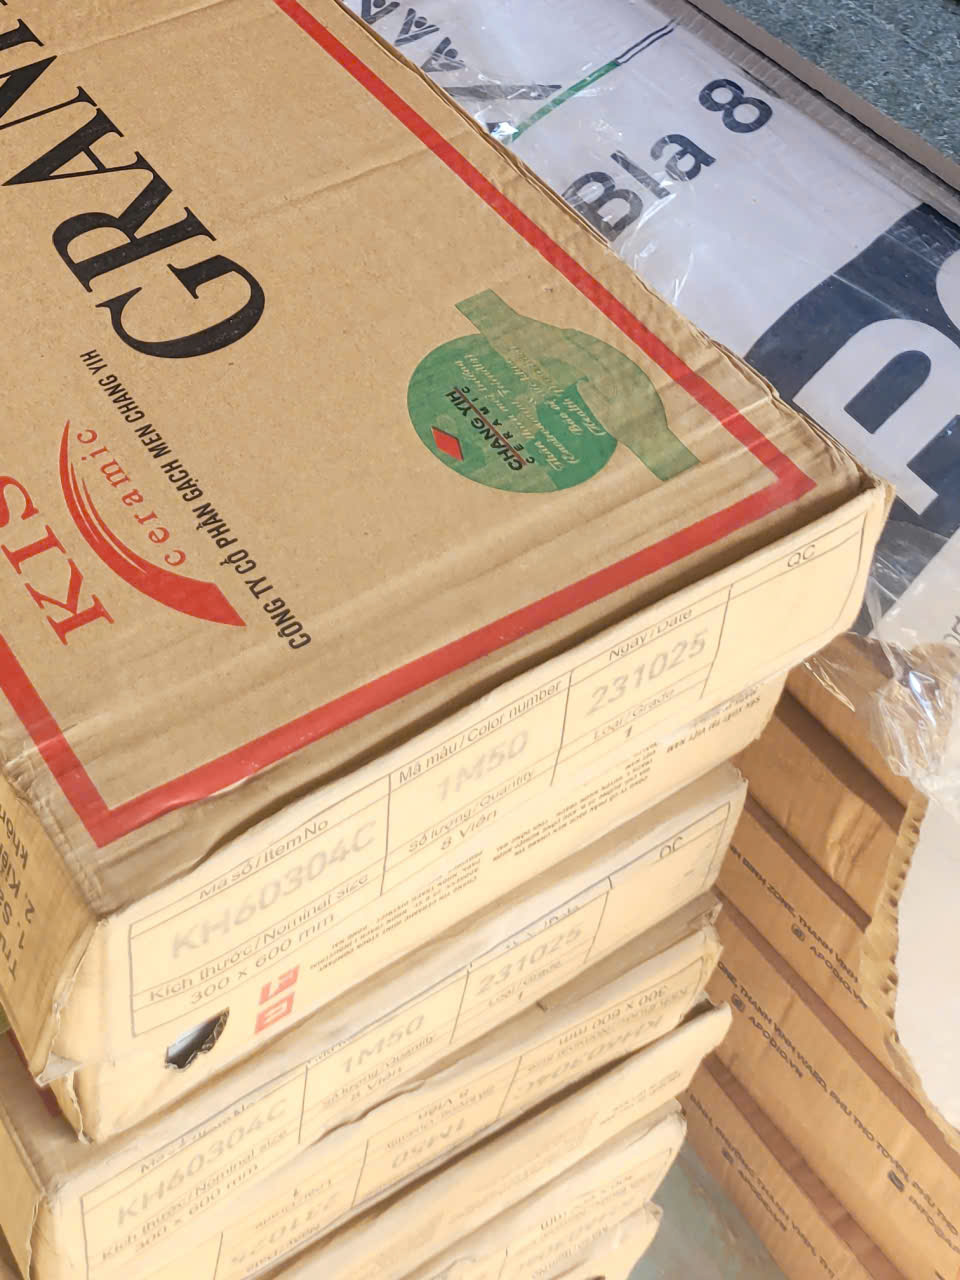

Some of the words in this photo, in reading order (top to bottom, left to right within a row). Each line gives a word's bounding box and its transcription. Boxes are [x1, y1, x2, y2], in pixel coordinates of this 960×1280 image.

[698, 78, 773, 134] 8
[80, 349, 107, 375] YIH
[98, 375, 144, 423] CHANG
[444, 390, 474, 418] YIH
[135, 424, 171, 459] MEN
[461, 386, 535, 464] CERAMIC
[471, 416, 523, 471] CHANG
[77, 429, 186, 567] ceramic
[161, 459, 203, 502] GẠCH
[193, 503, 238, 550] PHẦN
[220, 549, 256, 574] CỔ
[787, 544, 816, 568] QC
[245, 577, 274, 599] TY
[263, 597, 312, 649] CÔNG
[588, 630, 707, 714] 231025
[425, 741, 457, 769] màu
[467, 715, 505, 743] Color
[510, 681, 562, 724] number
[437, 732, 529, 800] 1M50
[441, 835, 453, 852] 8
[458, 808, 498, 840] Viên
[658, 835, 684, 860] QC
[191, 976, 230, 1005] 300
[237, 967, 248, 978] x
[255, 940, 293, 969] 600
[298, 912, 336, 940] mm
[477, 926, 581, 998] 231025
[150, 974, 194, 1002] Kích
[118, 1097, 288, 1228] KH60304C
